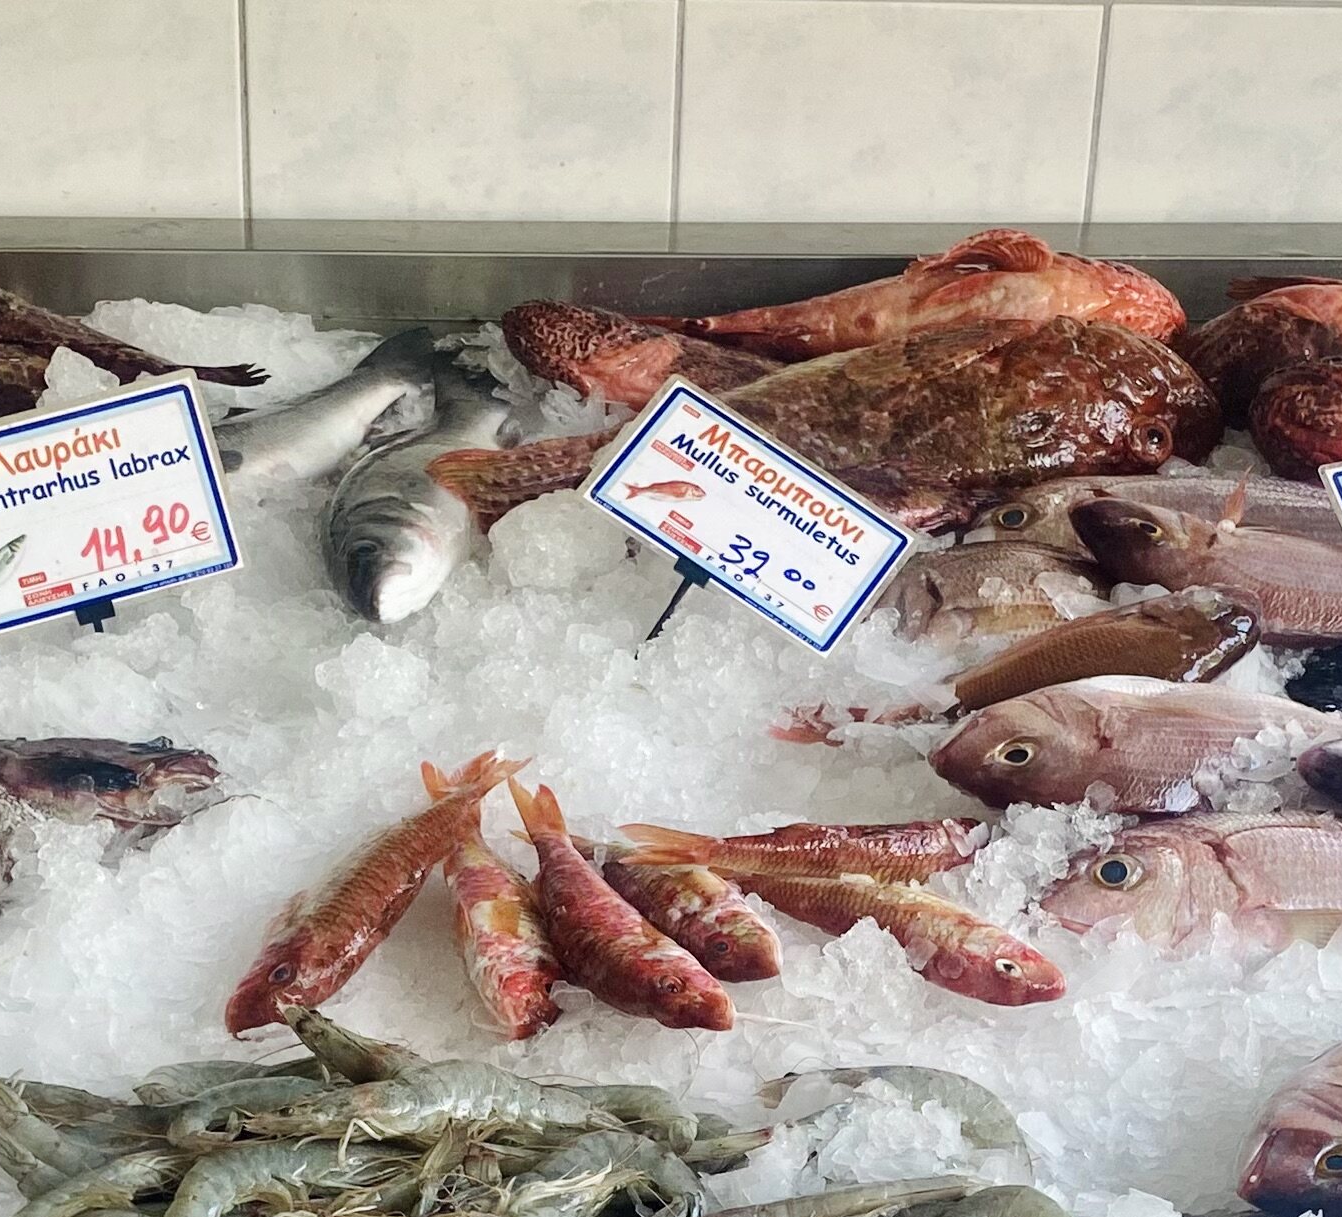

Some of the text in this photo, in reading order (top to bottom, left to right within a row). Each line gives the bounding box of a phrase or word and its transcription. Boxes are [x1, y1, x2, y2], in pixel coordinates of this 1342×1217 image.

[109, 445, 192, 480] labrax
[670, 432, 740, 485] Mullus
[745, 482, 861, 567] surmuletus
[698, 423, 866, 544] Μπαρμπούνι
